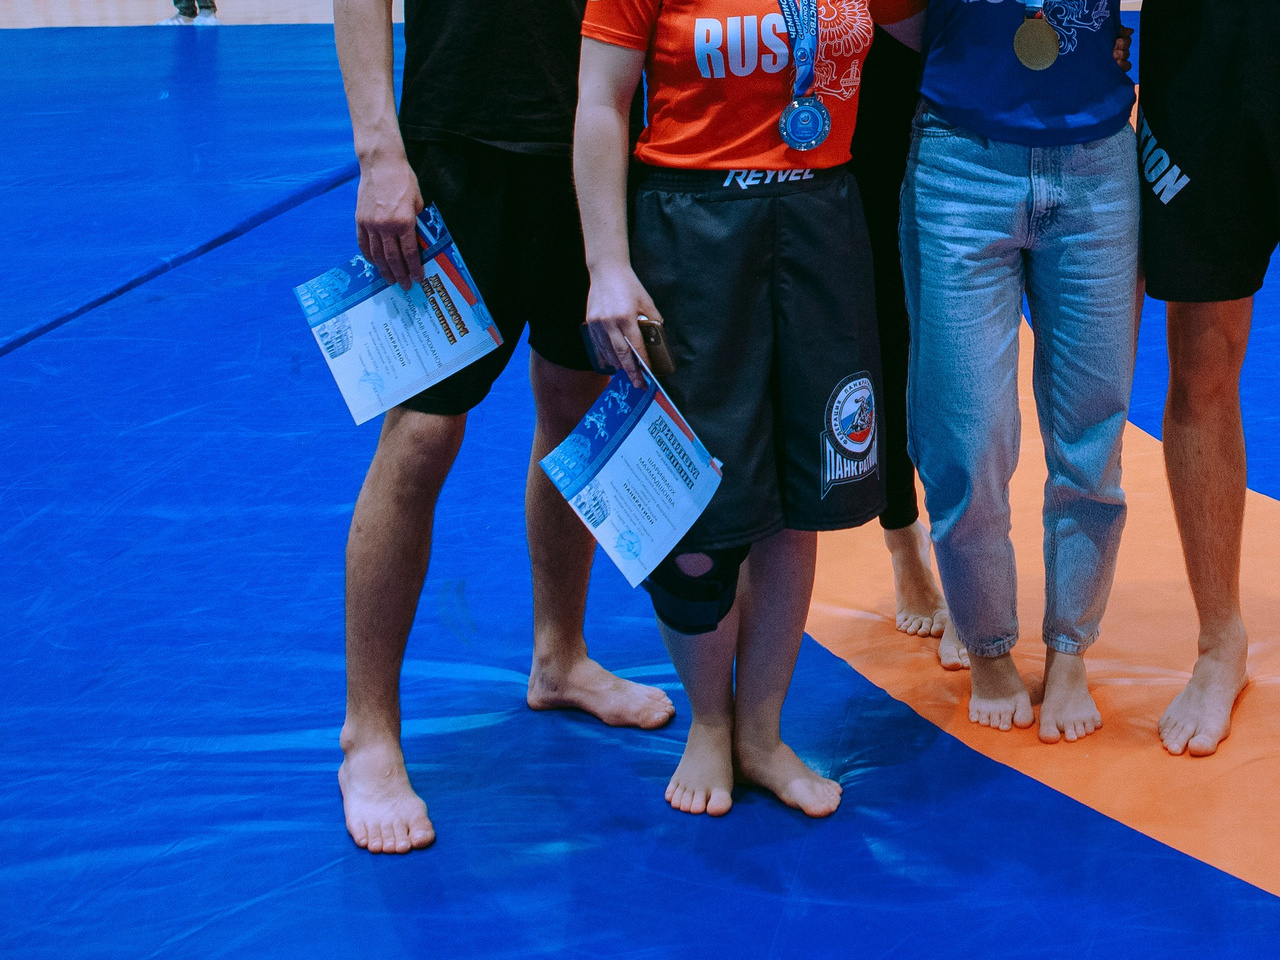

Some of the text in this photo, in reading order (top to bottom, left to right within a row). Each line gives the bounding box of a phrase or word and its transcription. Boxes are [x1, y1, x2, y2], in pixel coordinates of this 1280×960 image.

[694, 13, 789, 79] RUS
[427, 296, 457, 344] степени
[428, 272, 469, 337] ДИПЛОМ
[380, 322, 407, 367] ПАНКРАТИОН
